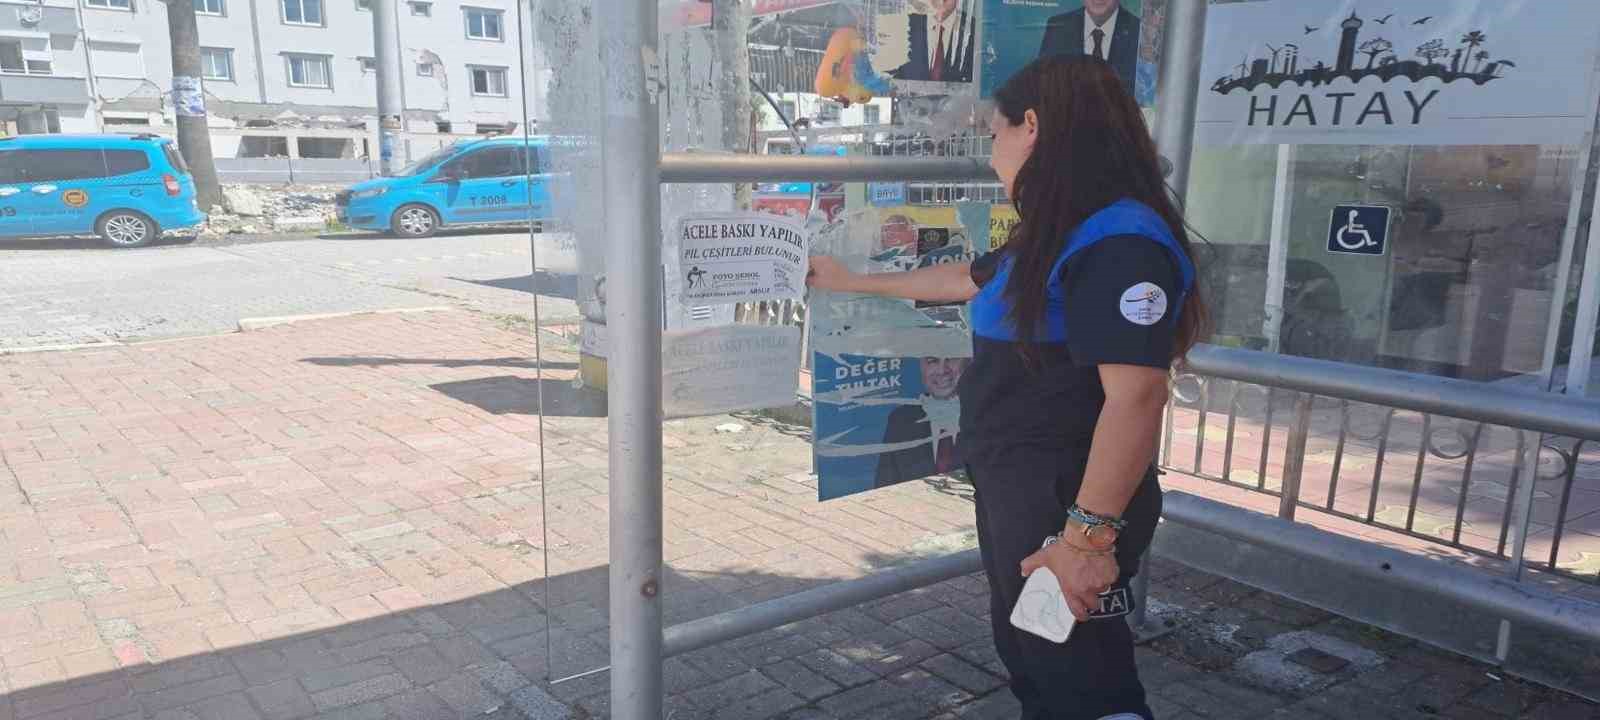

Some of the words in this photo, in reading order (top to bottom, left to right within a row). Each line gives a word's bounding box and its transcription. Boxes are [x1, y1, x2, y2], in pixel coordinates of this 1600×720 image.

[1247, 89, 1440, 127] HATAY
[682, 224, 718, 240] ACELE
[721, 223, 755, 239] BASKI
[760, 224, 802, 249] YAPILIR
[754, 247, 801, 265] BULUNUR
[835, 358, 902, 380] DEĞER
